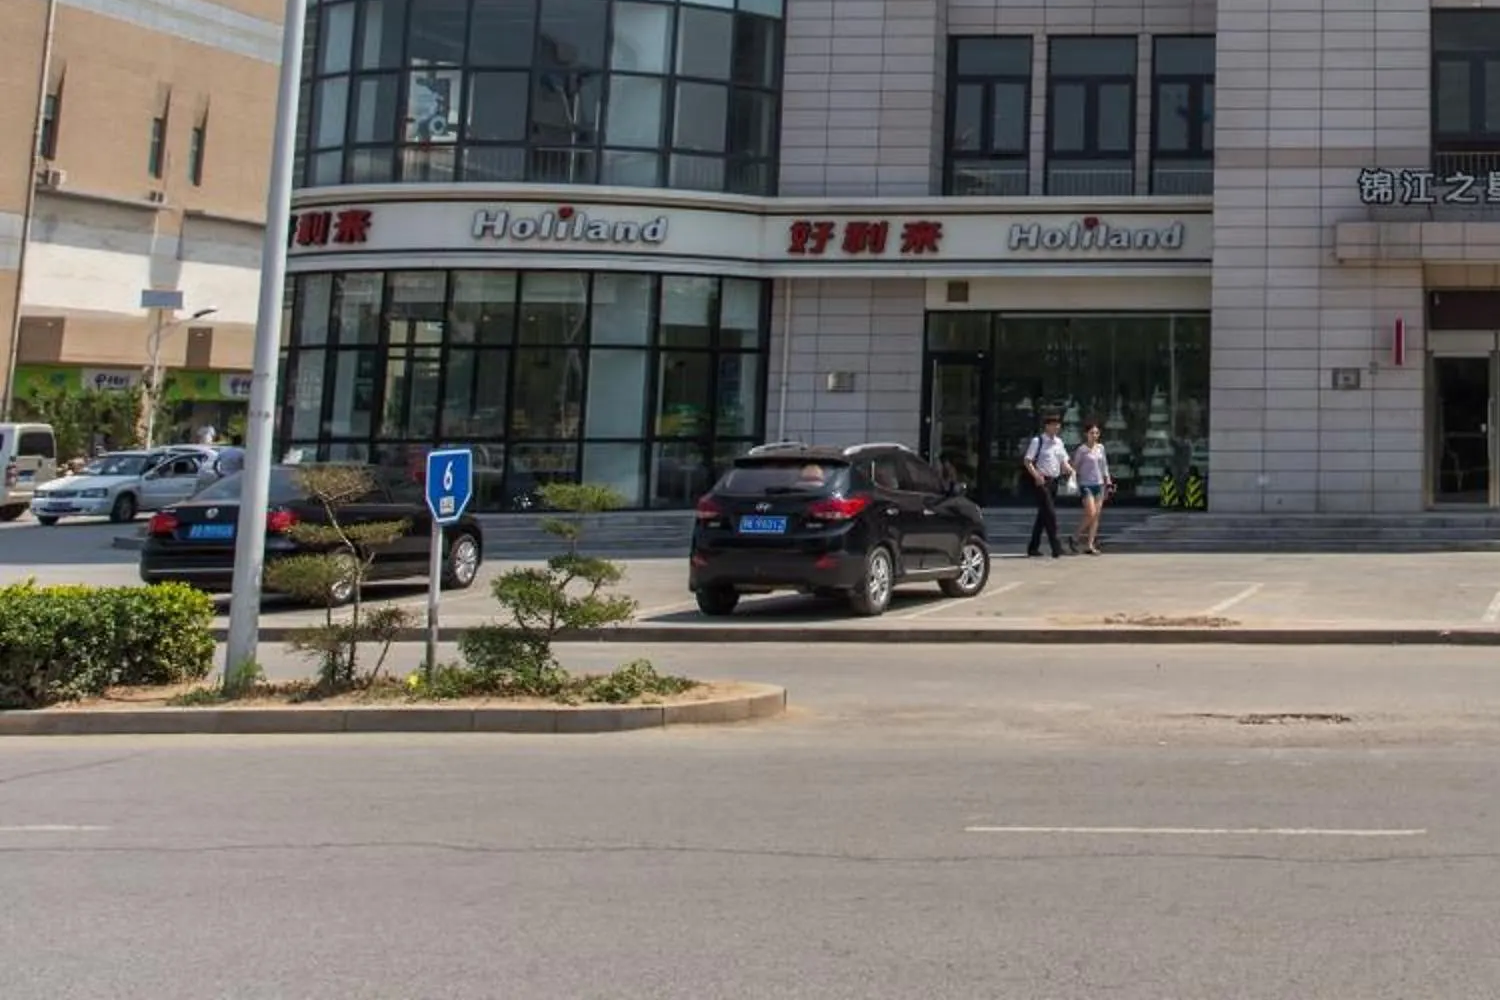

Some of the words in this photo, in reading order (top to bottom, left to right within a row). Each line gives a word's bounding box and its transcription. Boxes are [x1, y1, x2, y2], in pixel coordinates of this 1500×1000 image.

[471, 206, 669, 244] Holiland
[787, 220, 943, 255] 好利来
[1007, 217, 1186, 252] Holiland
[443, 460, 454, 492] 6
